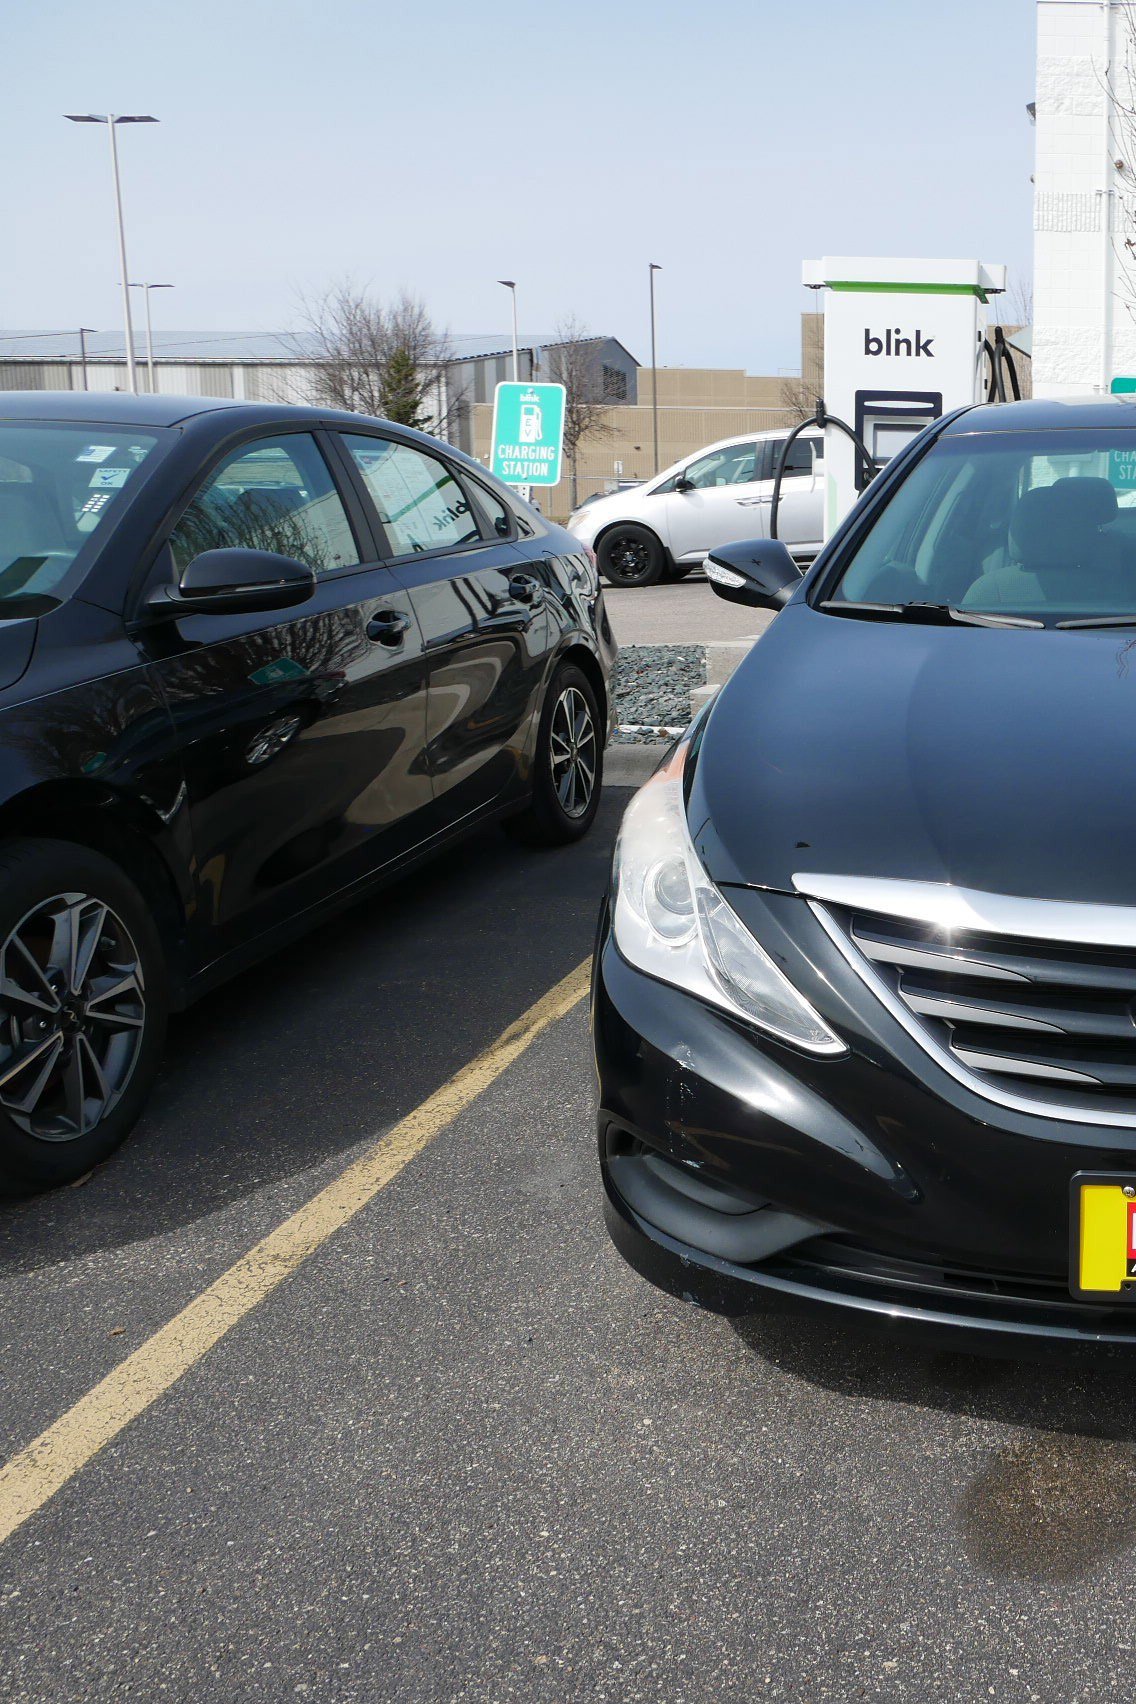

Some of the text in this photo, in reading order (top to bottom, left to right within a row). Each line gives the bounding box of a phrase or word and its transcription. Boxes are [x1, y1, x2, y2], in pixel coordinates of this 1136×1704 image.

[864, 328, 935, 357] blink
[498, 444, 555, 460] CHARGING
[502, 461, 549, 476] STATION
